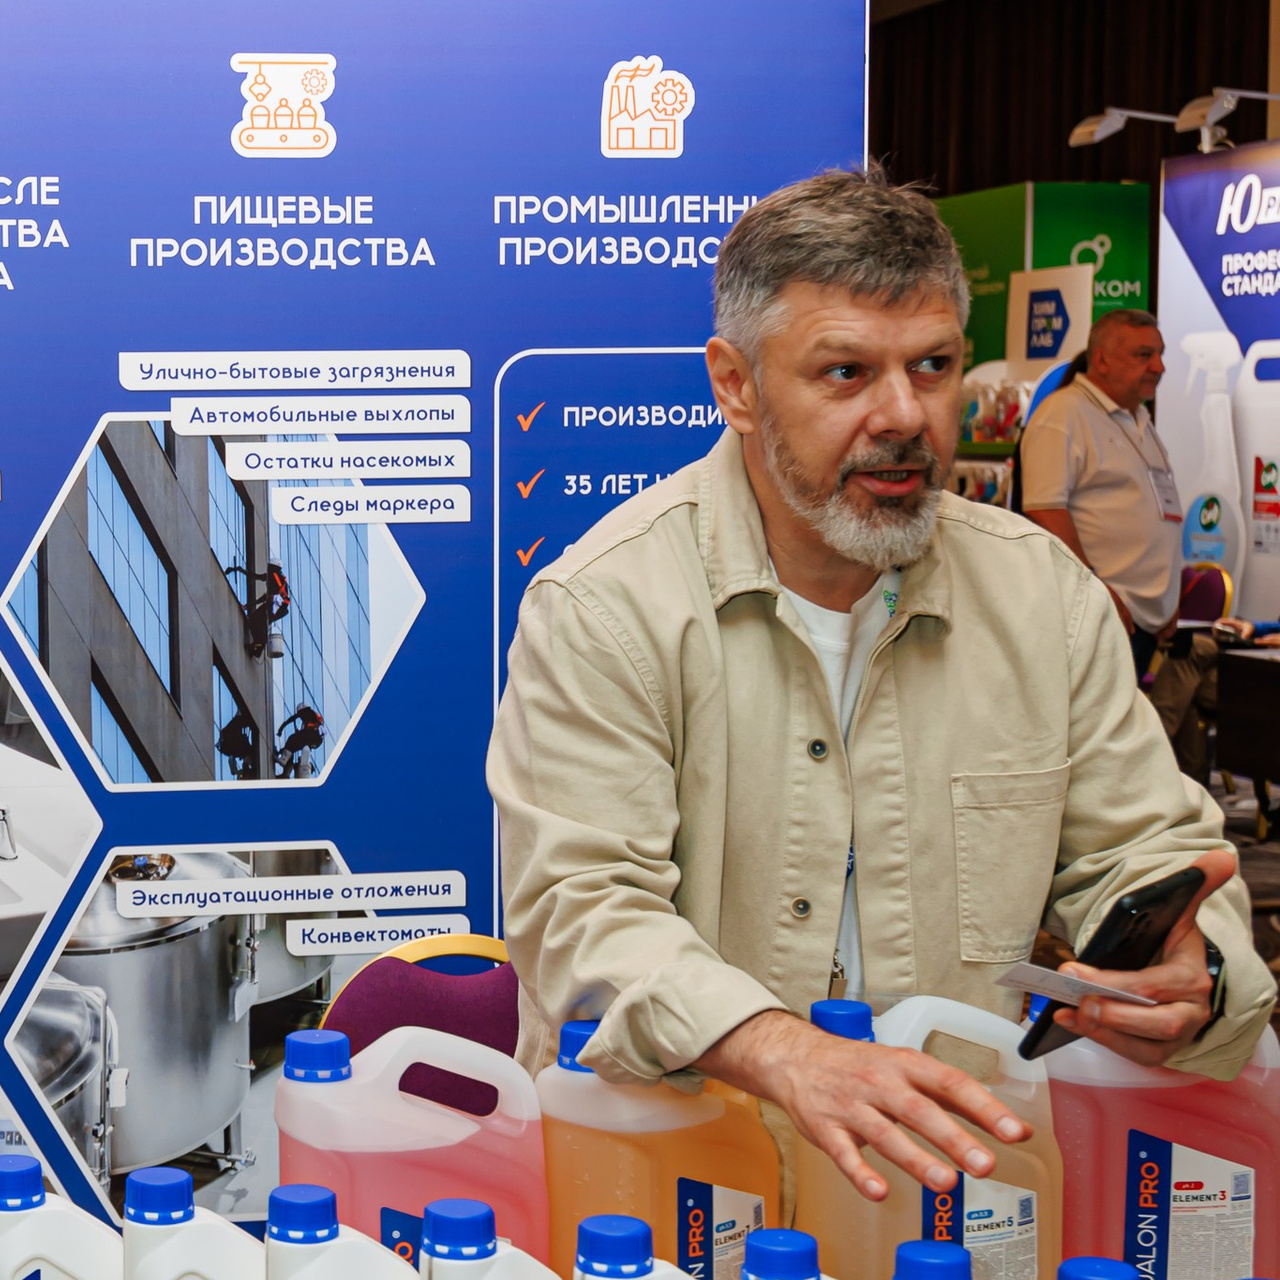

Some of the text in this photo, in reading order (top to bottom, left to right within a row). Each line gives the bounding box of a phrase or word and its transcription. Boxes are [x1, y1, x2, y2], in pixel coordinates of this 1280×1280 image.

[193, 195, 374, 229] ПИЩЕВЫЕ
[130, 236, 436, 270] ПРОИЗВОДСТВА
[139, 362, 456, 382] Улично-бытовые загрязнения
[189, 406, 456, 423] Автомобильные выхлопы
[244, 452, 456, 469] Остатки насекомых
[563, 473, 648, 495] 35 ЛЕТ
[291, 495, 456, 516] Следы маркера
[131, 881, 452, 908] Эксплуатационные отложения
[1139, 1161, 1159, 1208] PRO
[1172, 1189, 1227, 1204] ELEMENT 3
[688, 1208, 704, 1258] PRO
[965, 1216, 1015, 1233] ELEMENT 5
